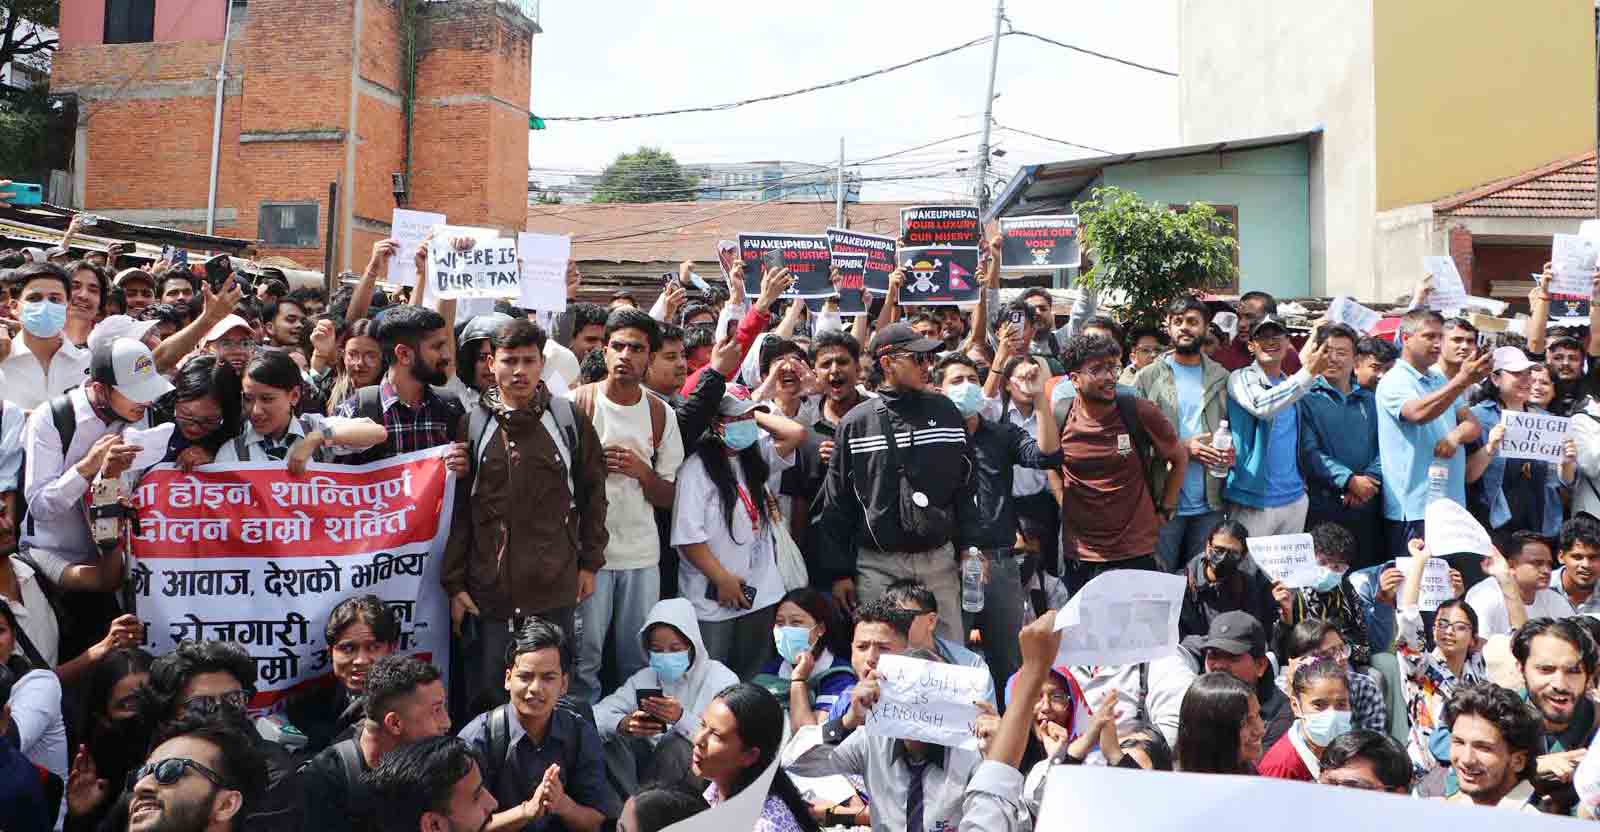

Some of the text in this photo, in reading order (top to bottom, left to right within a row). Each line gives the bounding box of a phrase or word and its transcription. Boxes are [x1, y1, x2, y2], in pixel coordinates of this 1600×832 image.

[905, 210, 978, 220] #WAKEUPNEPAL
[906, 220, 977, 229] YOUR LUXURY
[1004, 220, 1076, 228] #WAKEUPNEPAL
[910, 232, 933, 241] OUR
[1008, 228, 1073, 237] UNMUTE OUR
[743, 239, 827, 250] #WAKEUPNEPAL
[829, 233, 895, 251] #WAKEUPNEPAL
[1025, 240, 1056, 248] VOICE
[498, 248, 515, 265] IS
[437, 271, 518, 291] OUR TAX
[1505, 415, 1568, 432] ENOUGH
[1528, 431, 1541, 441] IS
[1503, 440, 1561, 456] ENOUGH
[271, 469, 413, 511] शान्तिपूर्ण
[240, 510, 314, 544] हाम्रो
[264, 560, 343, 598] देशको
[911, 695, 929, 705] IS
[883, 703, 944, 728] ENOUGH
